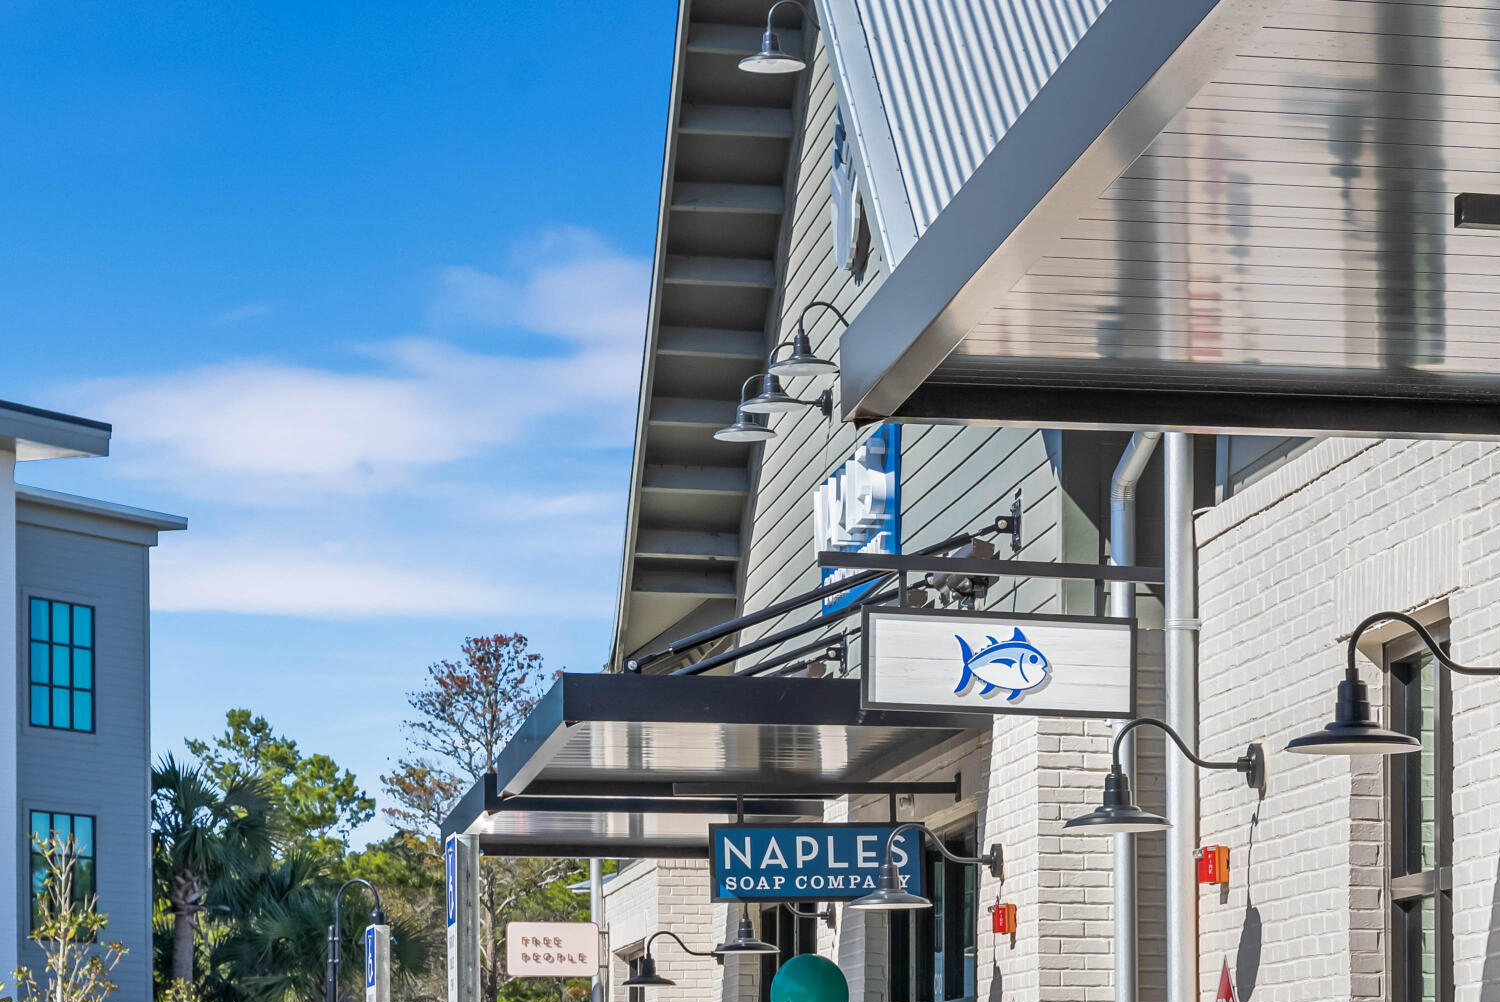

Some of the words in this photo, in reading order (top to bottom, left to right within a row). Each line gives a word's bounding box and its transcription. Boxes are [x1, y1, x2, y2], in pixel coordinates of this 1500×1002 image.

[724, 835, 908, 869] NAPLES
[725, 876, 786, 890] SOAP
[795, 874, 911, 889] COMPAY
[521, 936, 563, 948] FREE
[521, 952, 588, 964] PEOPLE
